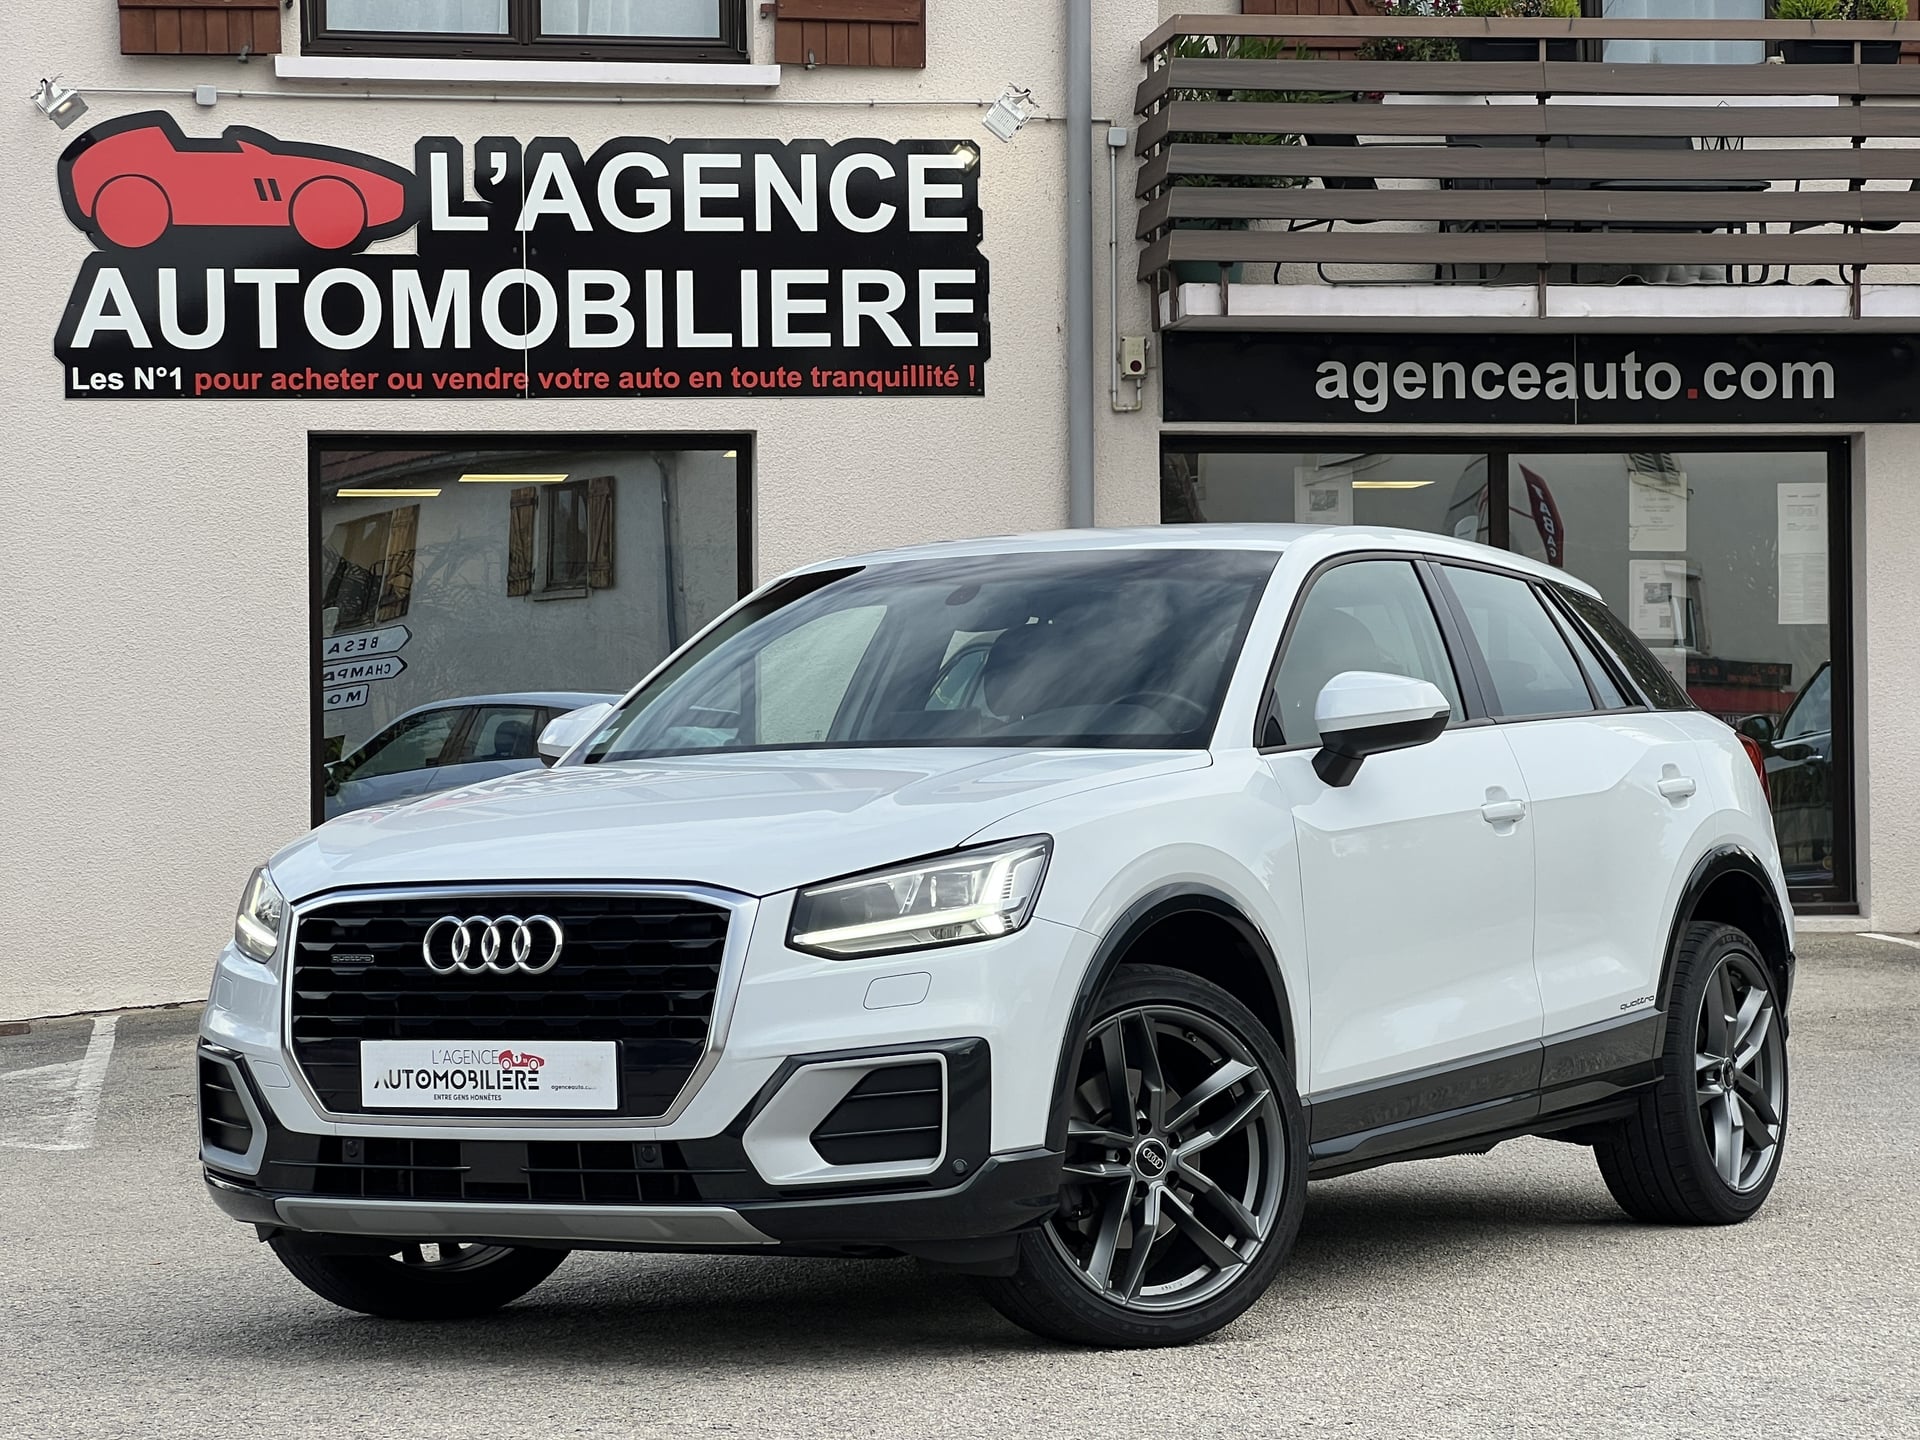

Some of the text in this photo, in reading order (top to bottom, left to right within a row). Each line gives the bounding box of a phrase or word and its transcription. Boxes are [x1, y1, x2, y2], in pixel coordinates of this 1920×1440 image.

[430, 152, 970, 234] L'AGENCE
[70, 267, 980, 350] AUTOMOBILIERE
[72, 366, 124, 390] Les
[134, 366, 182, 390] N°1
[194, 371, 263, 395] pour
[271, 366, 379, 390] acheter
[387, 371, 423, 390] ou
[431, 366, 530, 390] vendre
[538, 367, 610, 390] votre
[618, 366, 681, 389] auto
[688, 370, 722, 389] en
[731, 366, 802, 389] toute
[811, 364, 960, 393] tranquillité
[1314, 350, 1836, 413] agenceauto.com
[1620, 995, 1655, 1011] quattro
[431, 1049, 499, 1065] L'AGENCE
[433, 1093, 452, 1101] ENTRE
[452, 1093, 469, 1101] GENS
